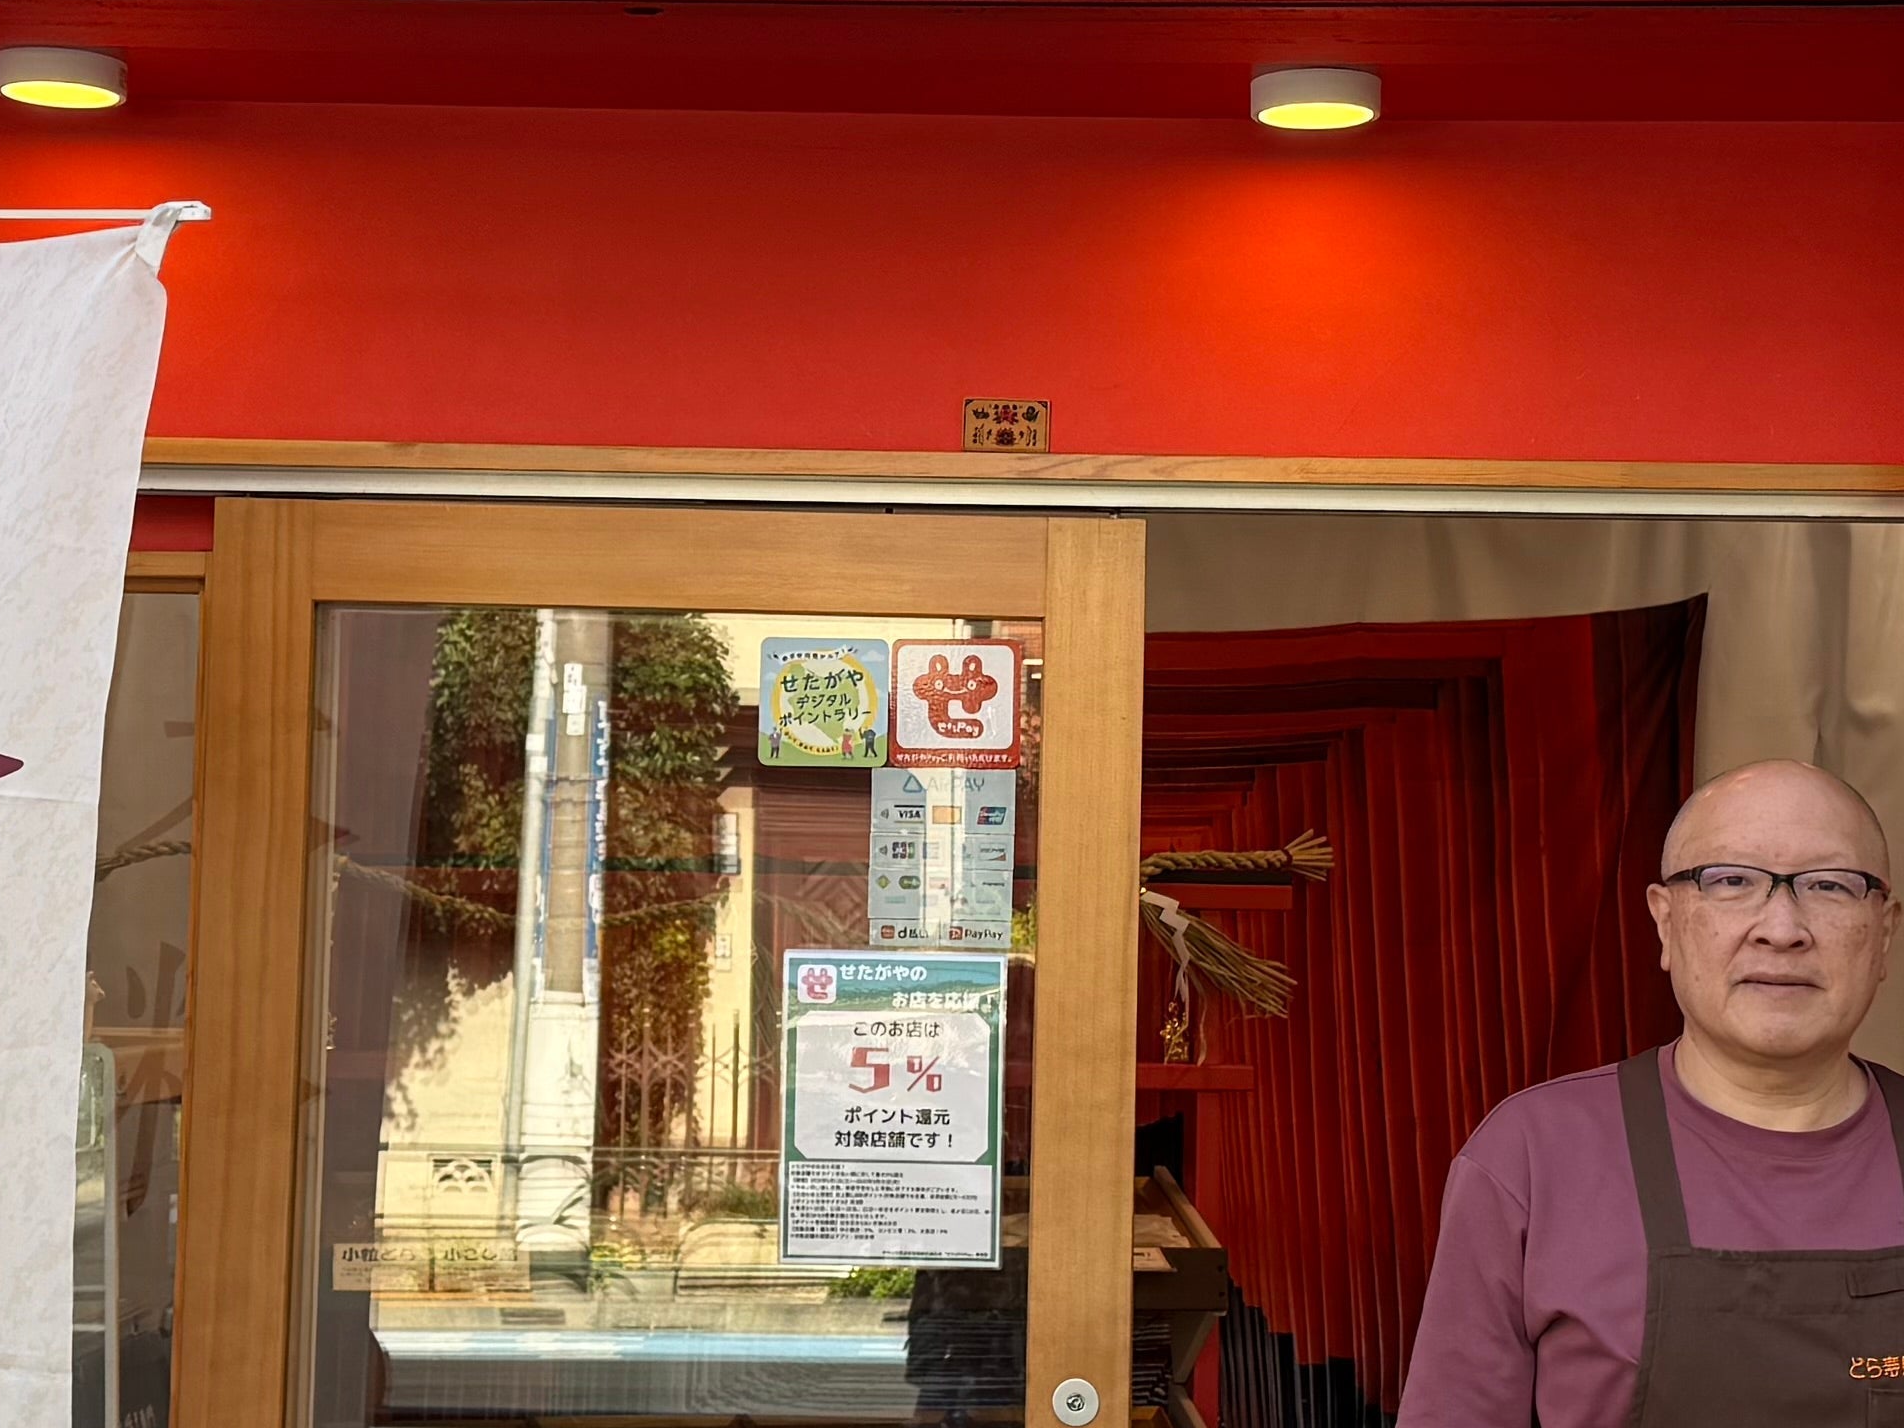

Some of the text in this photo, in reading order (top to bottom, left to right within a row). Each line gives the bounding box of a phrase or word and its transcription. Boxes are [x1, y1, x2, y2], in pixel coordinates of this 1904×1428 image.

[780, 668, 863, 693] せたがや
[796, 693, 851, 709] デジタル
[779, 708, 871, 726] ポイントラリー
[897, 810, 921, 819] VISA
[964, 928, 1003, 941] PayPay
[840, 964, 927, 981] せたがやの
[854, 1021, 940, 1038] このお店は
[844, 1106, 950, 1125] ポイント還元
[835, 1130, 953, 1149] 対象店舗です！
